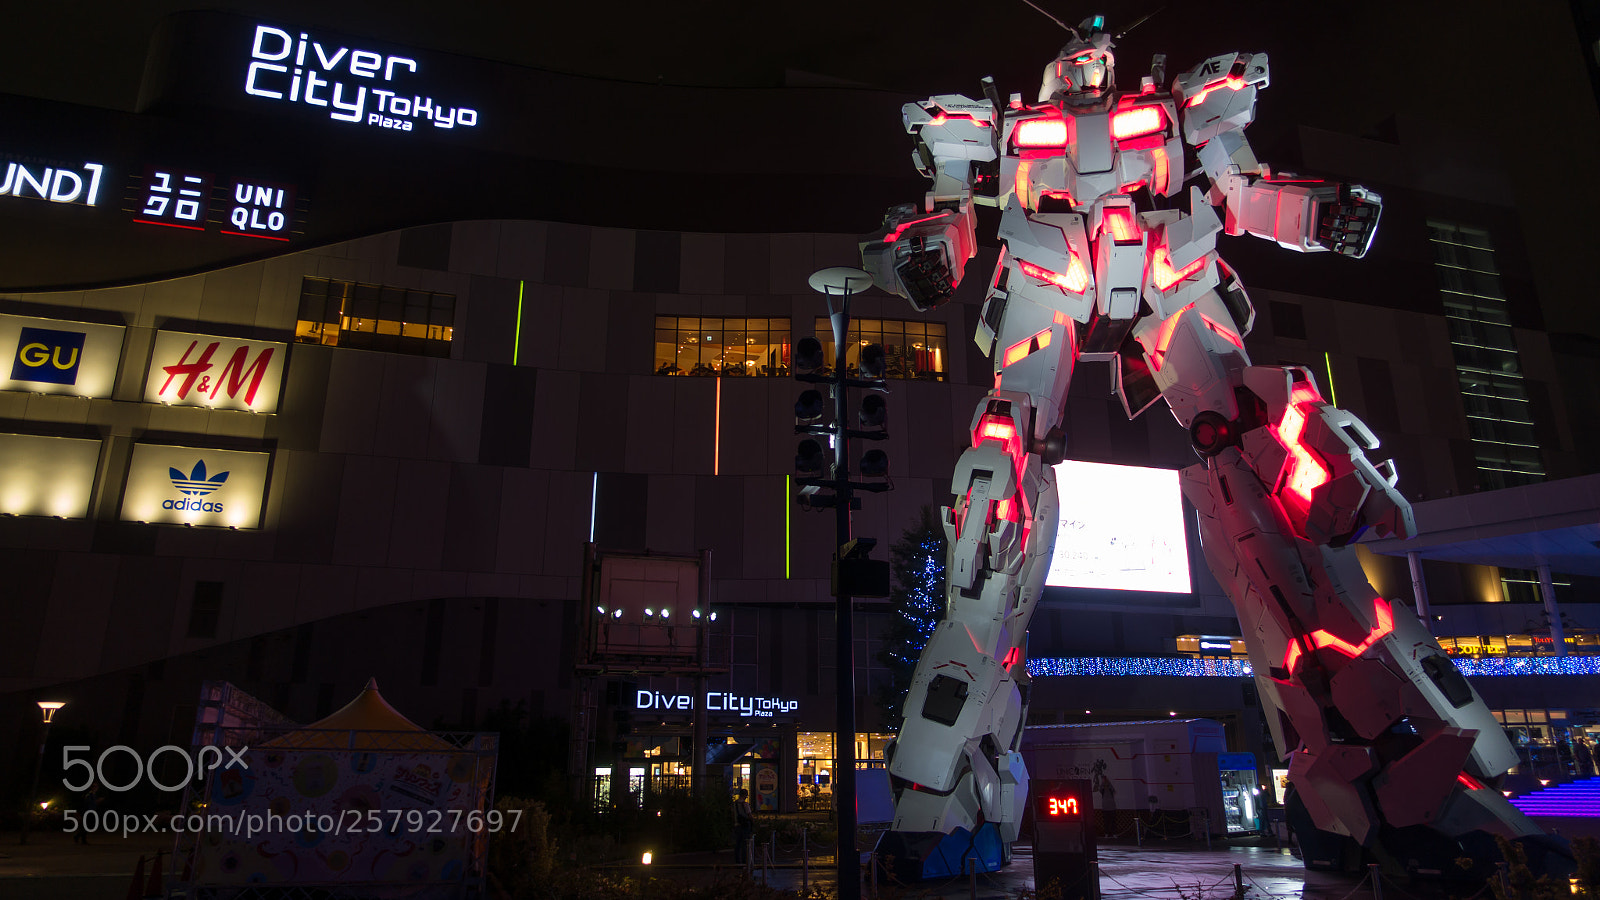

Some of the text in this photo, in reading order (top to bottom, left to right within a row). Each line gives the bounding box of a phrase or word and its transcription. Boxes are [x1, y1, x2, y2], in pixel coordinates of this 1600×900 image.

[251, 25, 417, 81] Diver
[245, 61, 366, 122] City
[368, 112, 413, 131] Plaza
[150, 172, 202, 197] ユニ
[235, 183, 284, 209] UNI
[143, 196, 200, 220] クロ
[231, 207, 285, 231] QLO
[19, 342, 79, 370] GU
[158, 340, 275, 406] H&M
[162, 497, 224, 513] adidas
[706, 692, 754, 717] City
[1049, 797, 1077, 815] 347
